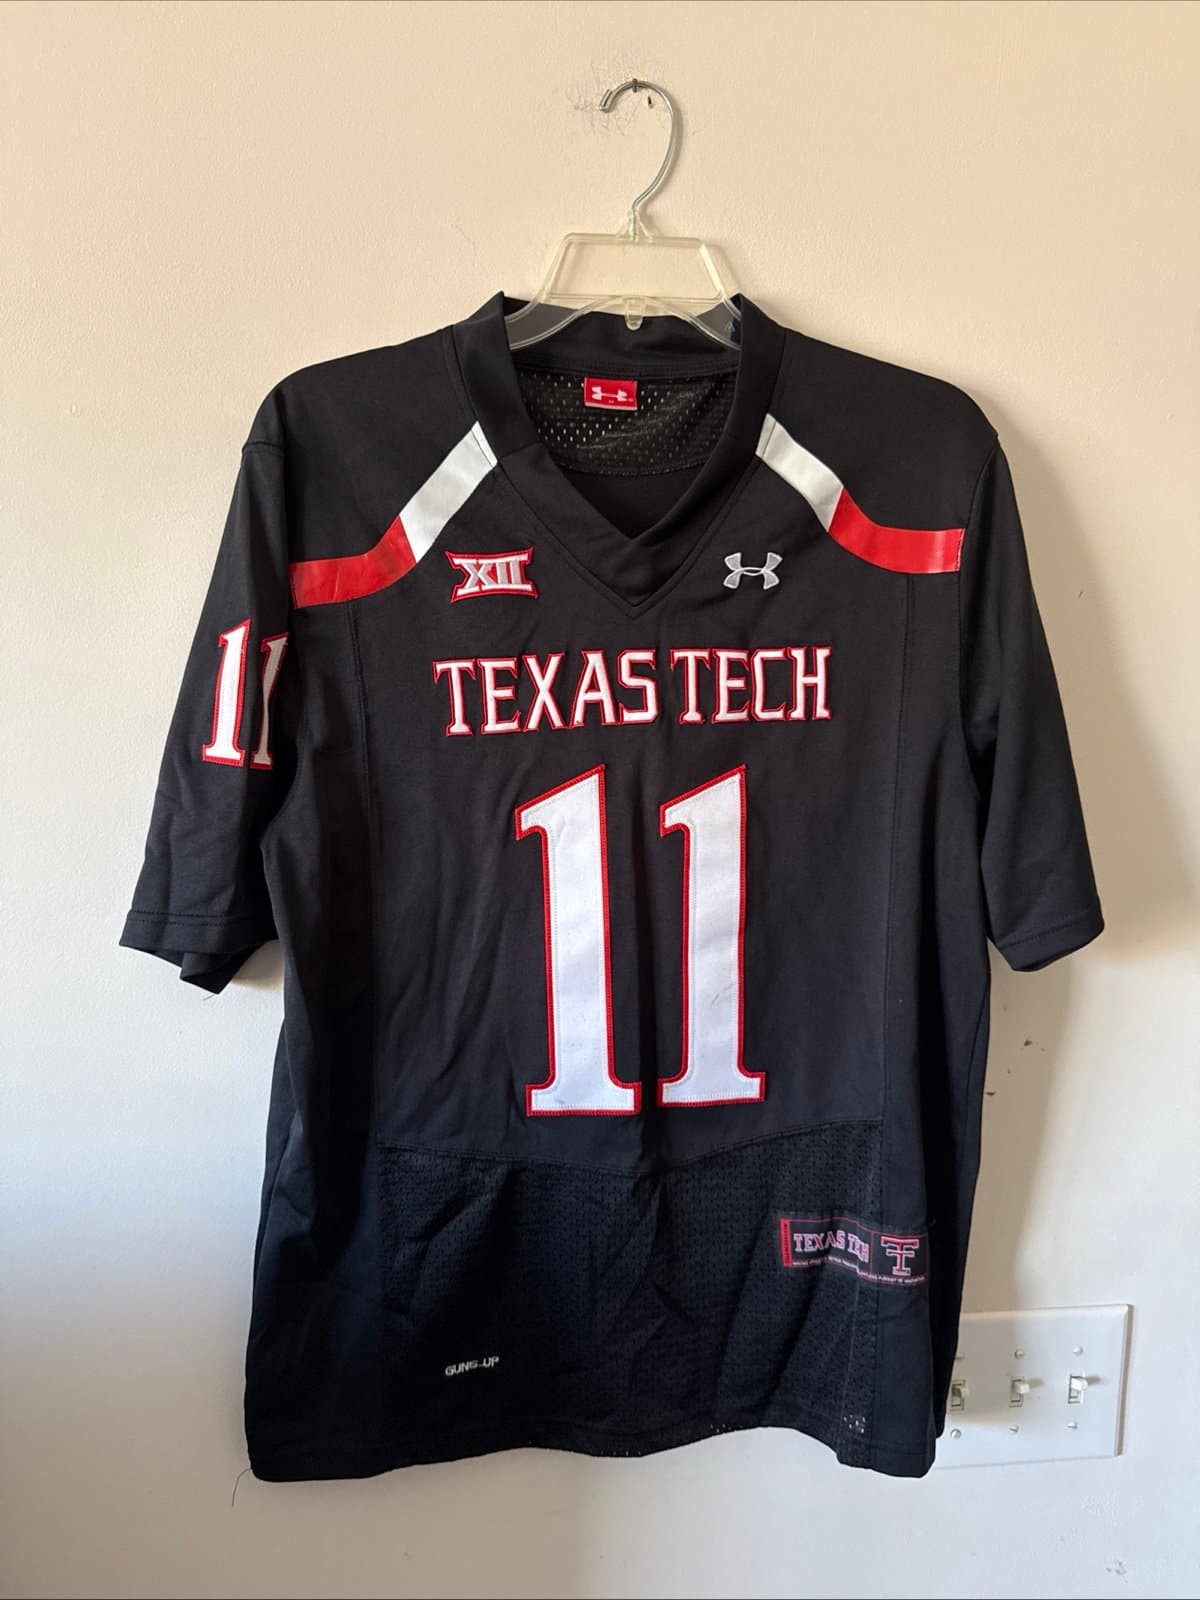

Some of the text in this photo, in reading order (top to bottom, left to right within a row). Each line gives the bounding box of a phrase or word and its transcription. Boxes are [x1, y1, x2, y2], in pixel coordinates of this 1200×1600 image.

[446, 548, 537, 603] XII
[202, 619, 289, 769] 11
[433, 647, 832, 736] TEXAS TECH
[515, 764, 766, 1116] 11
[793, 1230, 847, 1252] TEXAS
